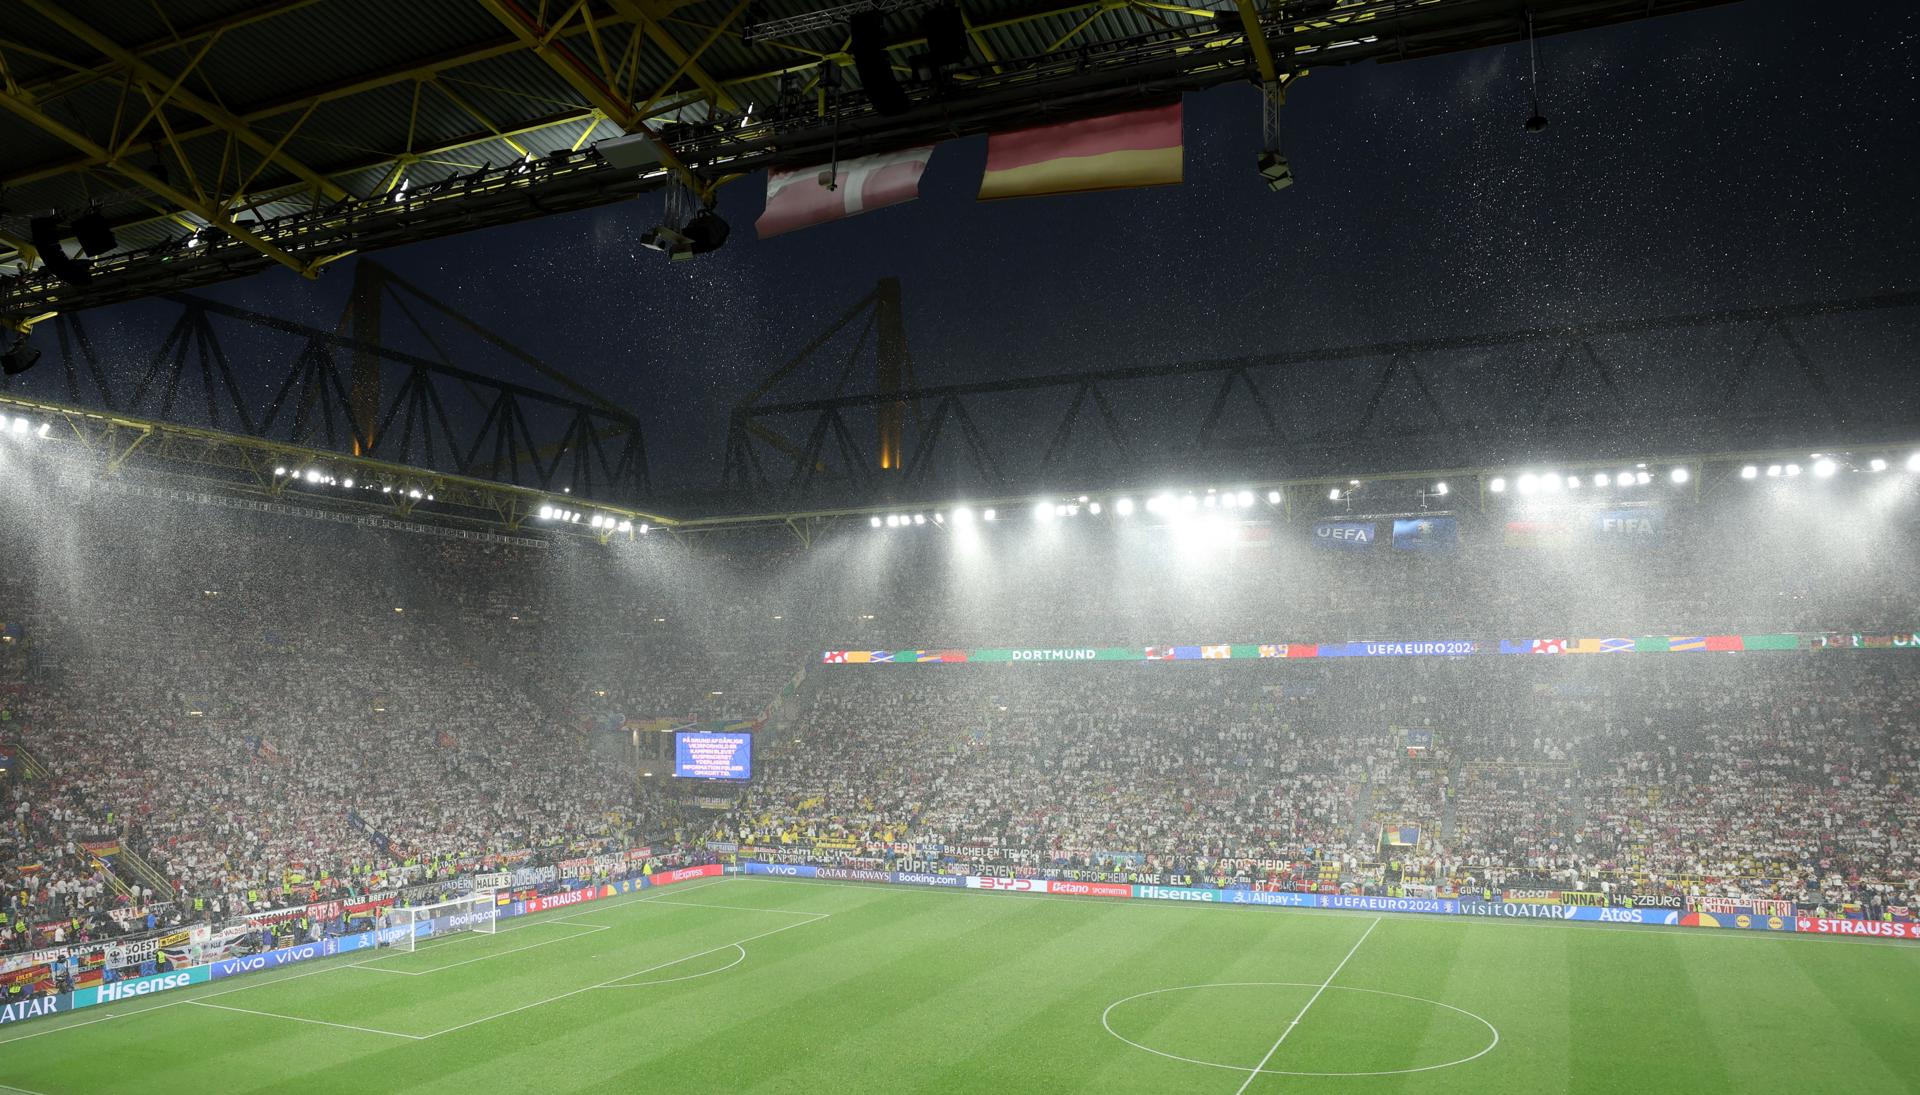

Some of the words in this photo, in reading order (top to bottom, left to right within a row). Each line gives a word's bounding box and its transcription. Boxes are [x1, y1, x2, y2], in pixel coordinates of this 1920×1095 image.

[1602, 518, 1654, 535] FIFA
[1317, 527, 1367, 542] UEFA
[1012, 650, 1096, 660] DORTMUND
[944, 845, 999, 856] BRACHELEN
[1220, 859, 1292, 871] GROHEIDE
[672, 868, 704, 881] AliExpress
[817, 868, 847, 878] QATAR
[851, 869, 889, 881] AIRWAYS
[899, 872, 957, 885] Booking.com
[1081, 870, 1128, 883] PFORHEIM
[477, 878, 499, 890] HALLE
[980, 877, 1031, 891] BYD
[1052, 881, 1089, 893] Betano
[343, 896, 366, 907] ADLER
[369, 891, 399, 903] BRETTEN
[1141, 884, 1213, 901] Hisense
[542, 890, 582, 909] STRAUSS
[1562, 893, 1595, 906] UNNA
[1612, 894, 1681, 907] HARZBURG
[1818, 919, 1906, 936] STRAUSS
[125, 940, 157, 955] SOEST
[96, 972, 191, 1004] Hisense
[0, 995, 58, 1024] ATAR
